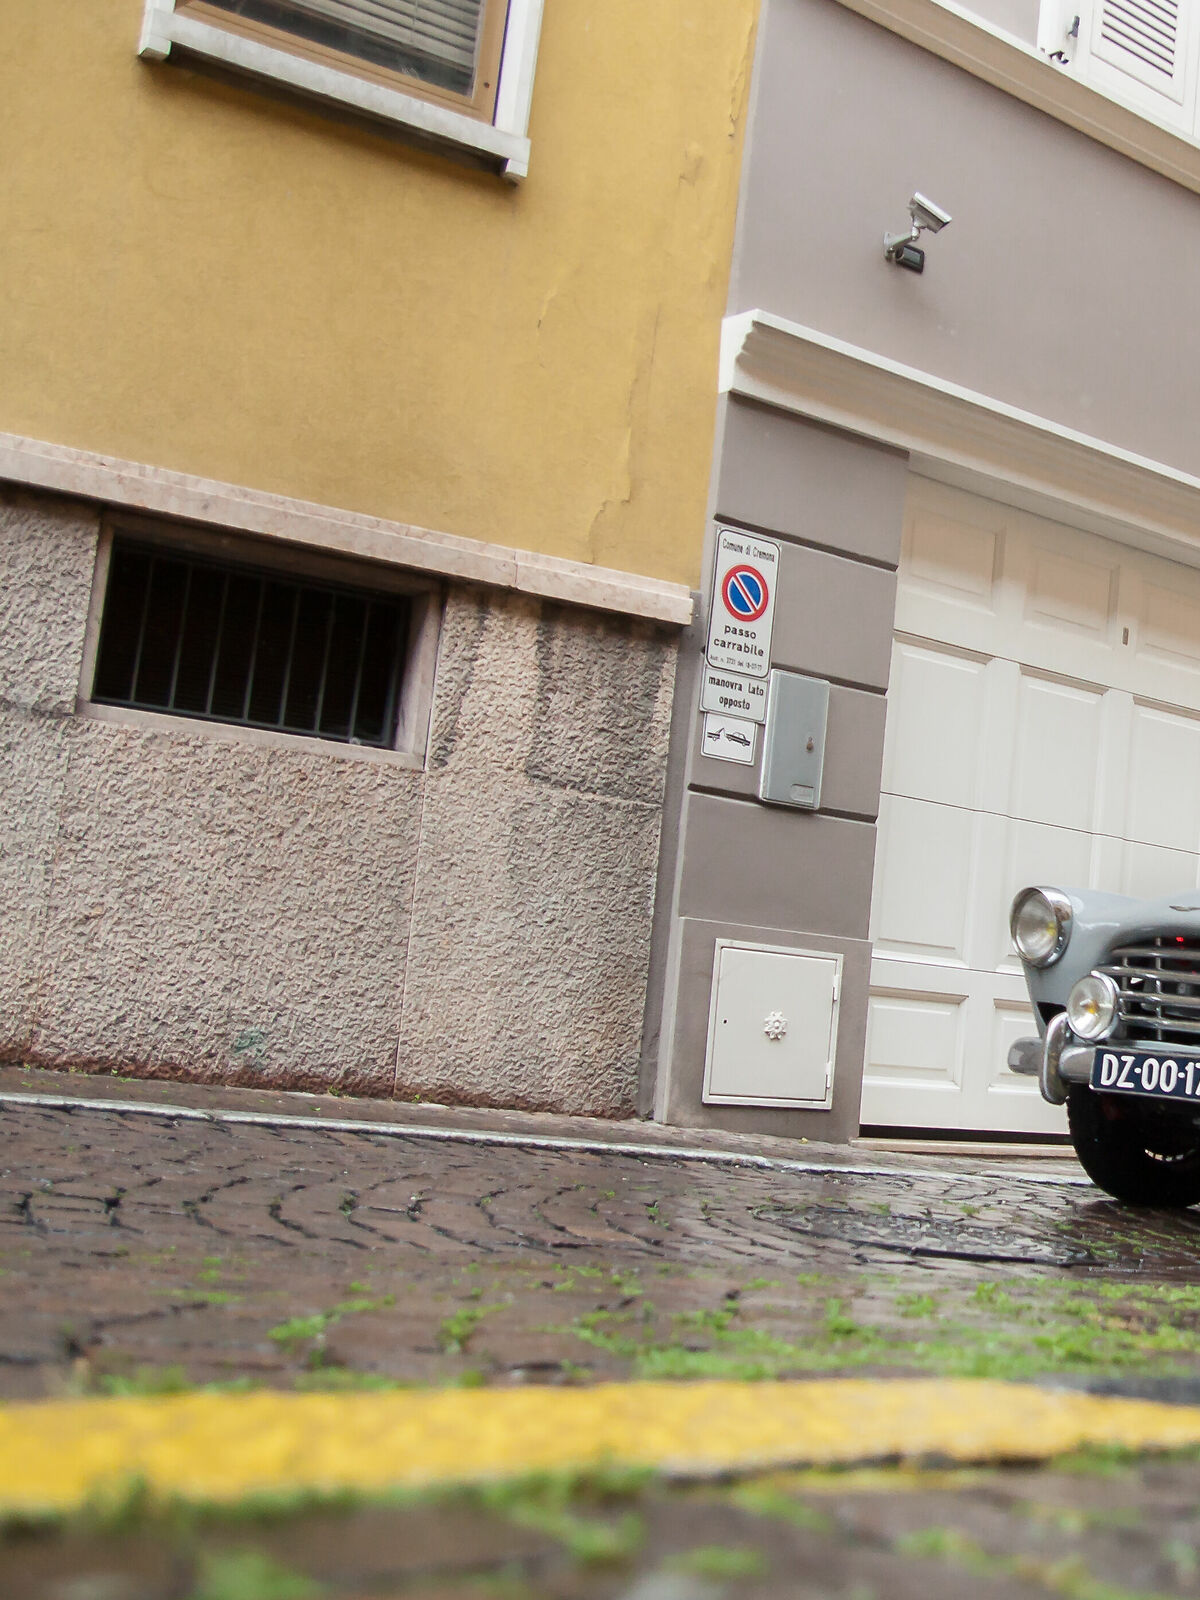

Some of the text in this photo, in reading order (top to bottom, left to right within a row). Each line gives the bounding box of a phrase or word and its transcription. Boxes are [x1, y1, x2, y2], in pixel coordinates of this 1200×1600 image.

[722, 538, 775, 562] Comune di Cremona
[724, 625, 757, 639] passo
[714, 638, 764, 656] carrabile
[708, 676, 764, 696] manovra lato
[719, 696, 750, 710] opposto
